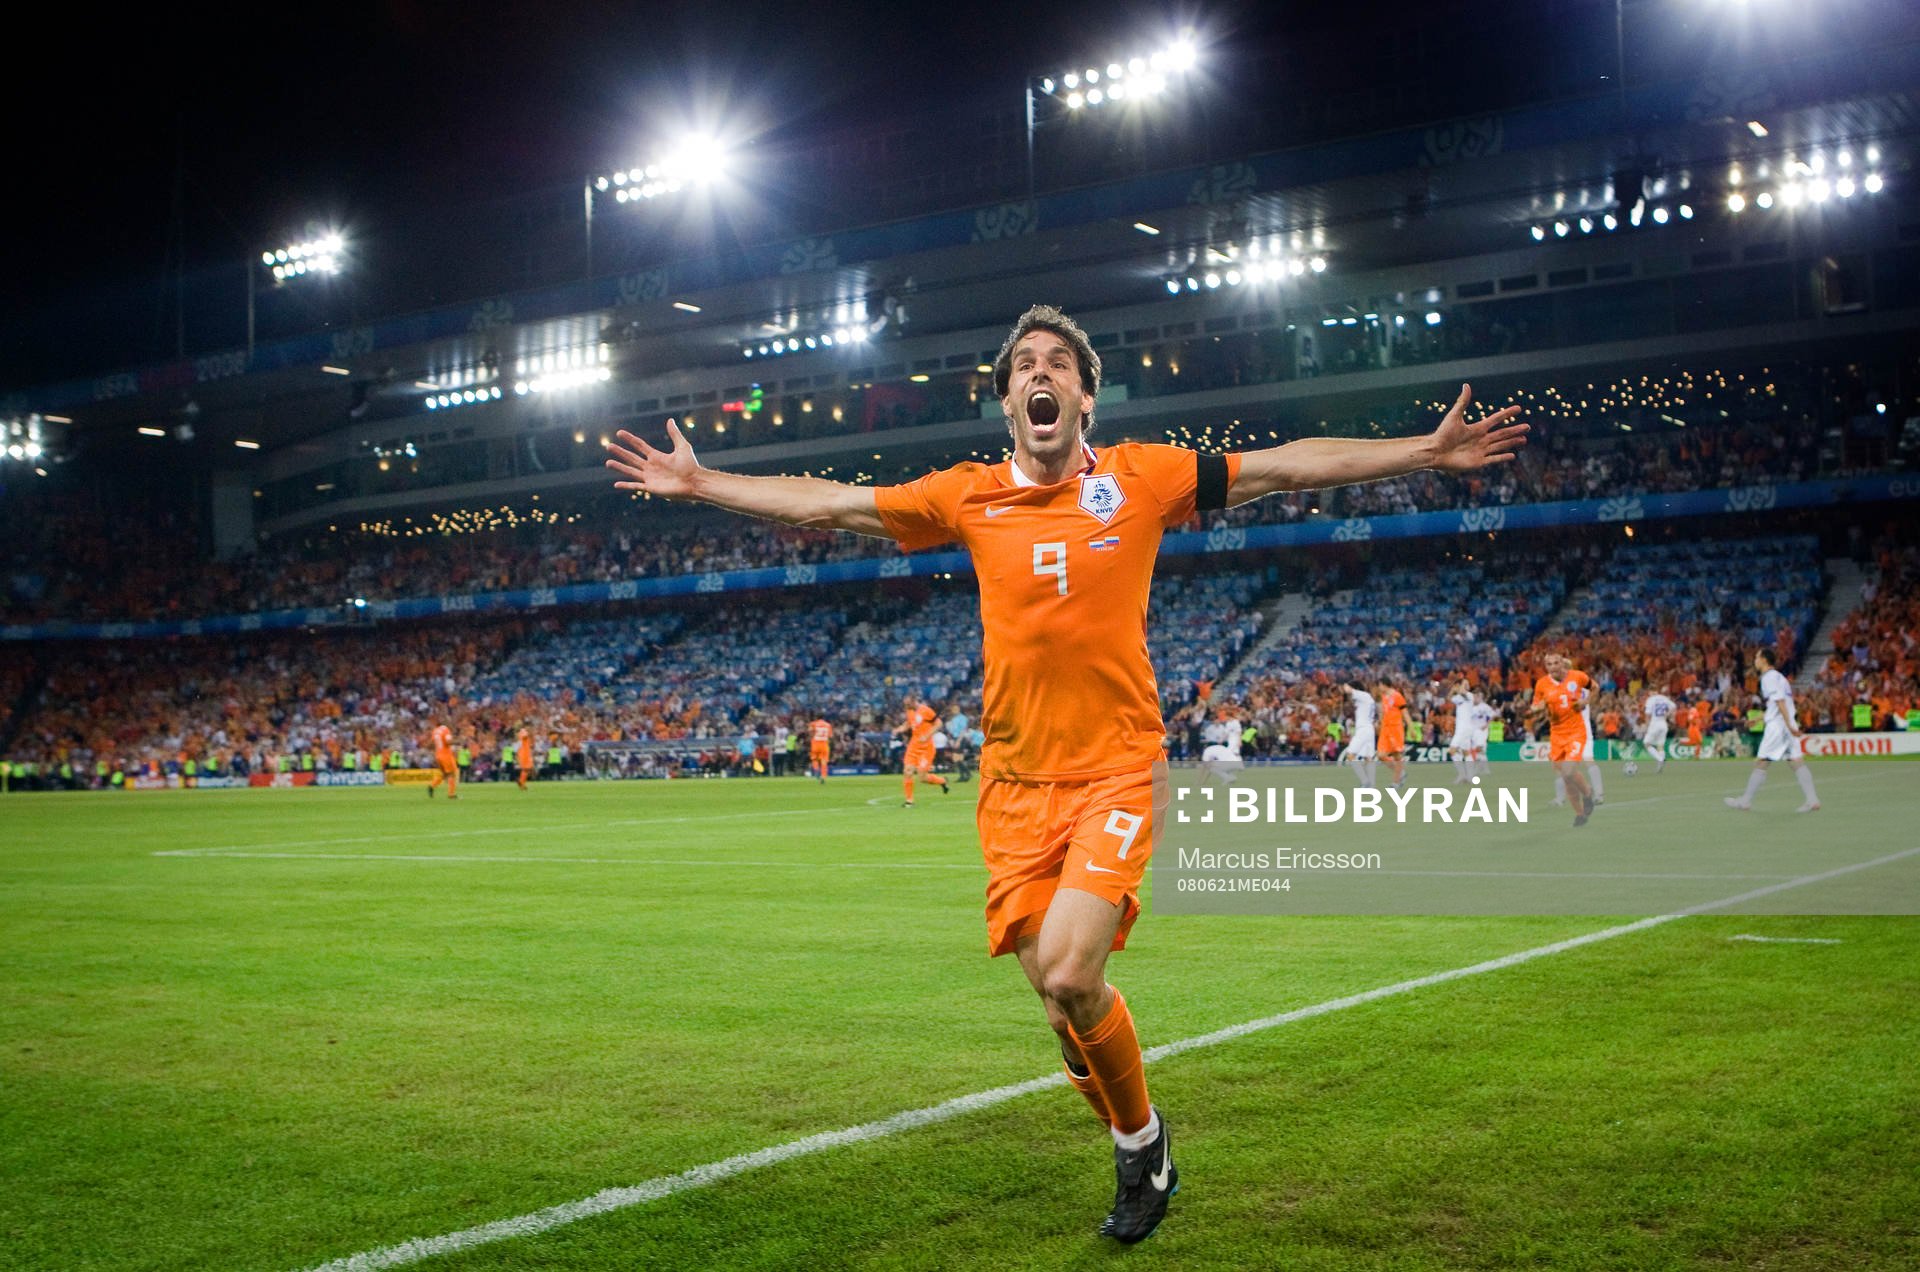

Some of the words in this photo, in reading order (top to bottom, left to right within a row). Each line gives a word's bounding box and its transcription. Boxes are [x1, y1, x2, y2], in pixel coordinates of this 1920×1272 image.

[1095, 506, 1113, 514] KNVB
[1033, 541, 1068, 596] 9
[1559, 694, 1568, 708] 3
[1416, 746, 1451, 762] zer
[1800, 735, 1893, 756] Canon
[1104, 809, 1143, 861] 9
